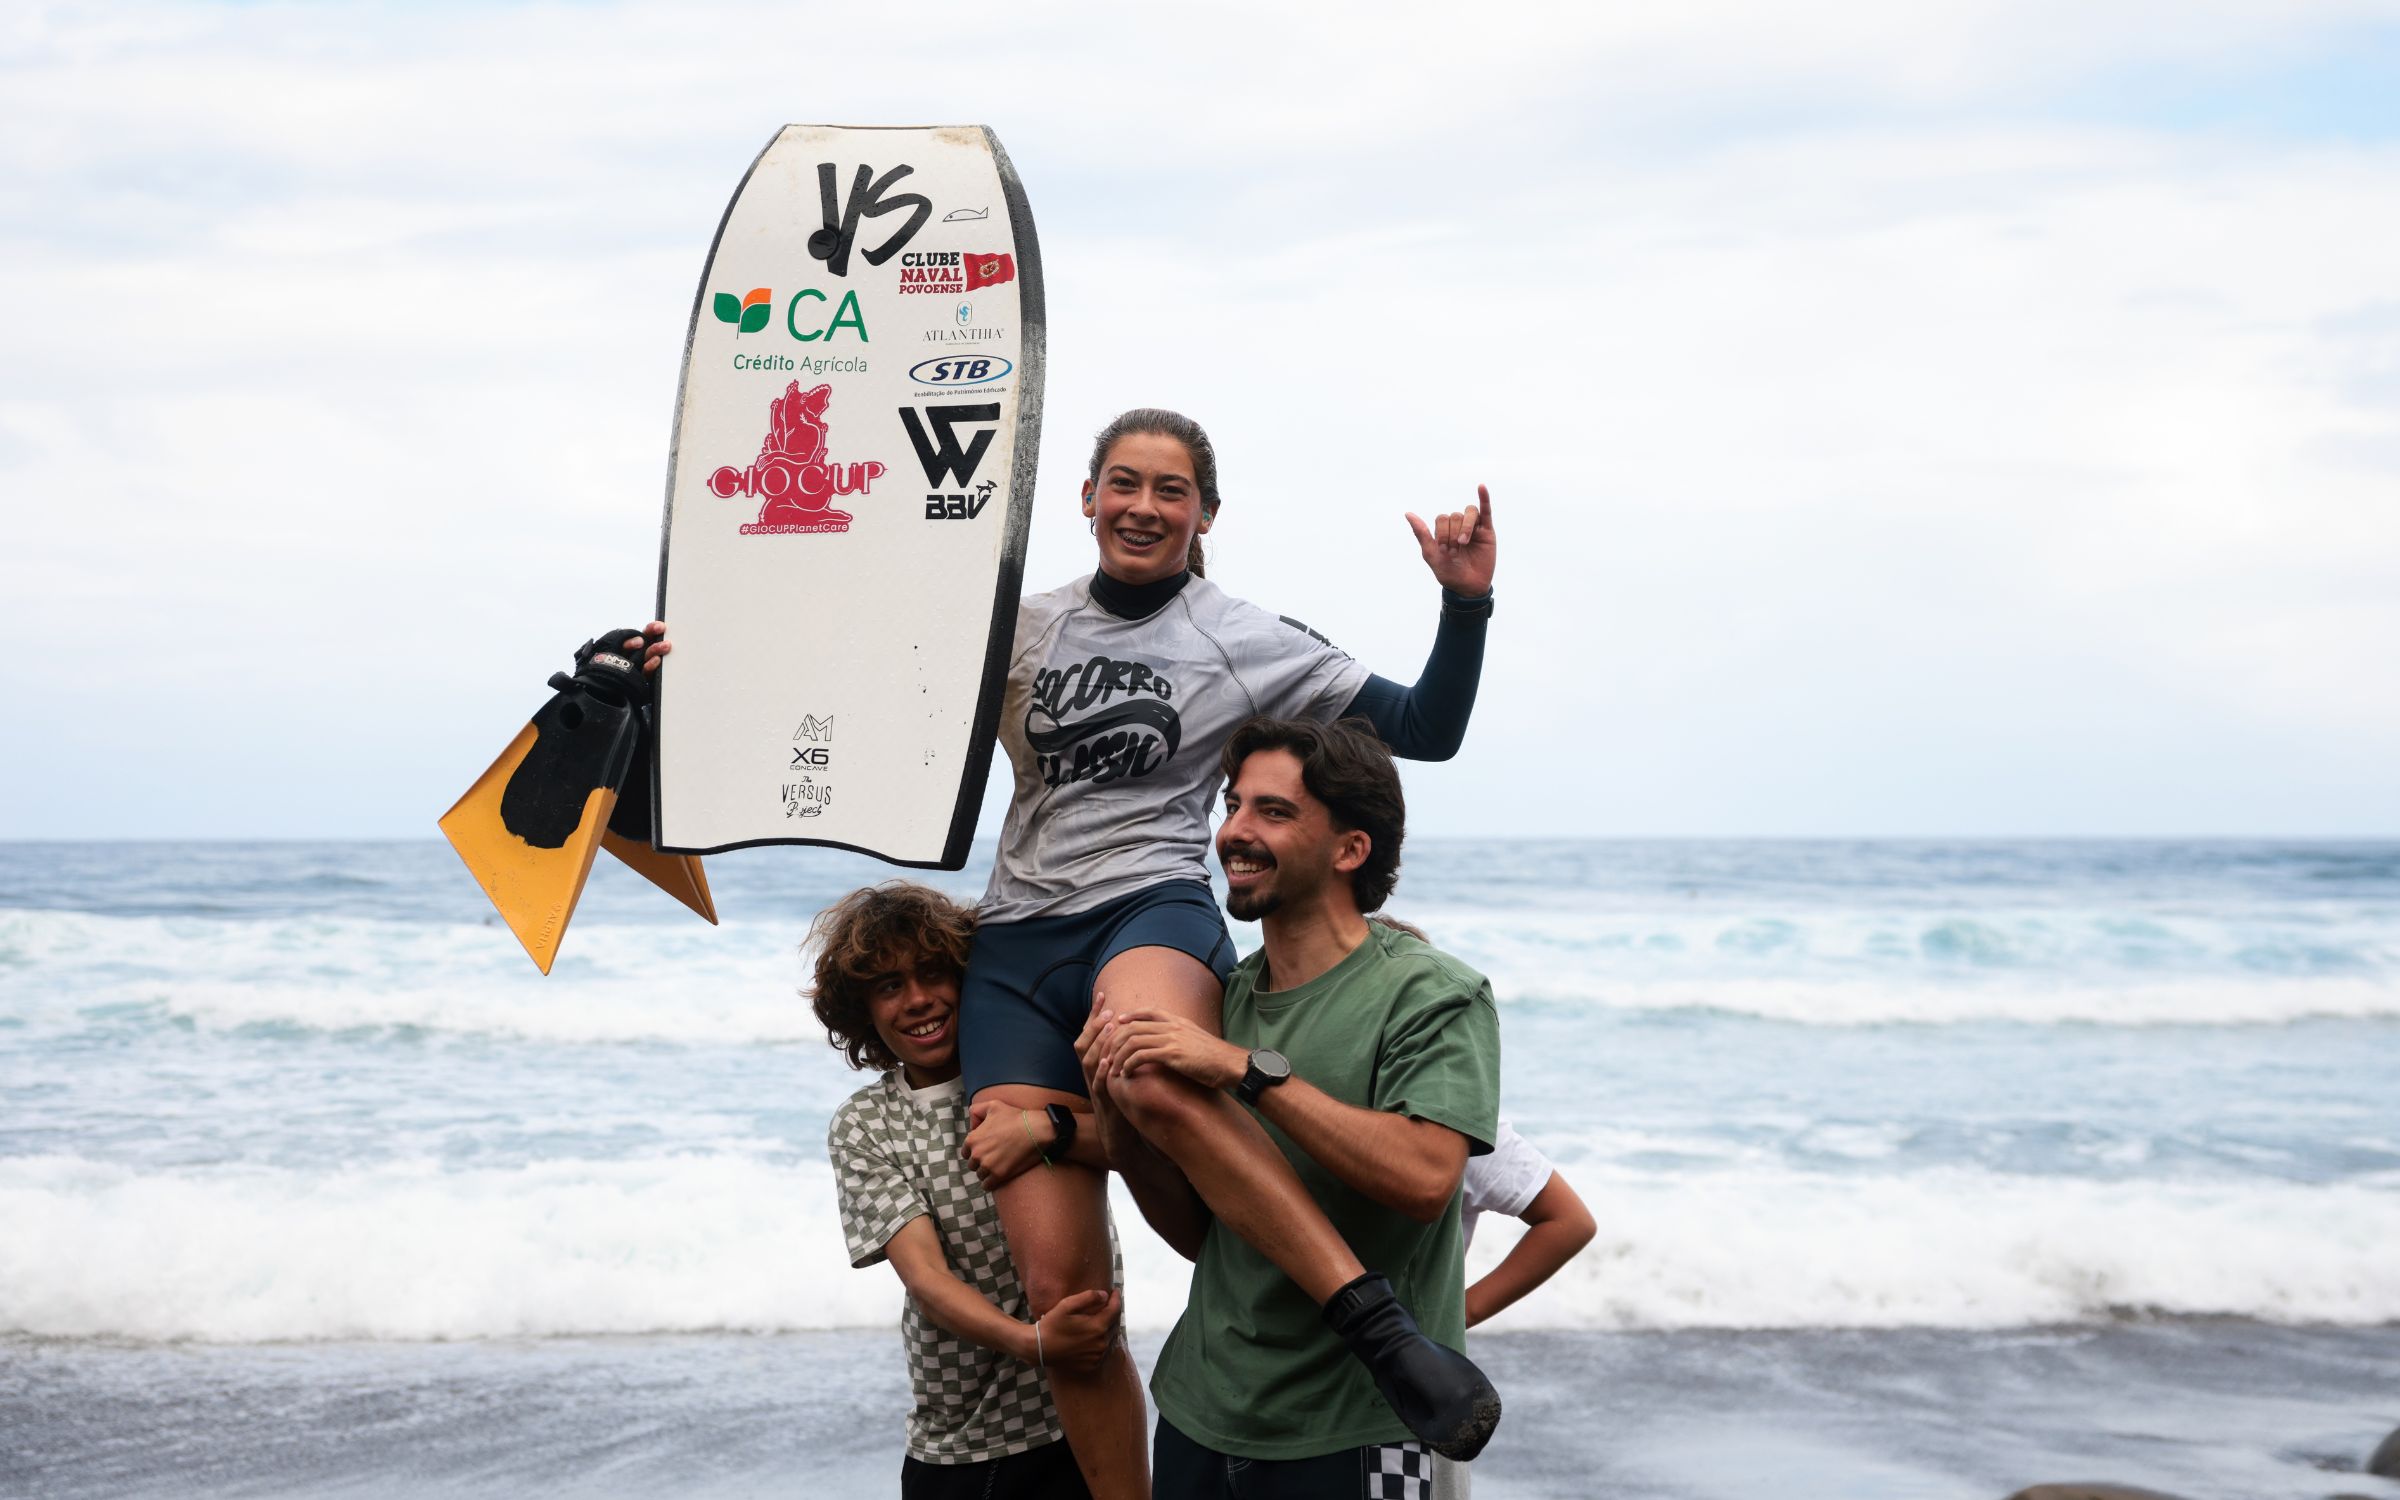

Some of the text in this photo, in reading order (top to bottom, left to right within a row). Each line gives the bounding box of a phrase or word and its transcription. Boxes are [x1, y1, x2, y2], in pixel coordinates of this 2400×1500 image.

[902, 252, 960, 267] CLUBE
[900, 268, 963, 283] NAVAL
[899, 284, 963, 294] POVOENSE
[787, 288, 869, 343] CA
[733, 354, 868, 375] Crédito Agrícola
[930, 359, 991, 382] STB
[710, 463, 885, 497] GIOCUP
[925, 492, 991, 520] BBV
[740, 522, 850, 534] #GIOCUPPlanetCare
[1031, 655, 1172, 719] SOCORRO
[791, 747, 829, 765] X6
[782, 783, 832, 806] VERSUS
